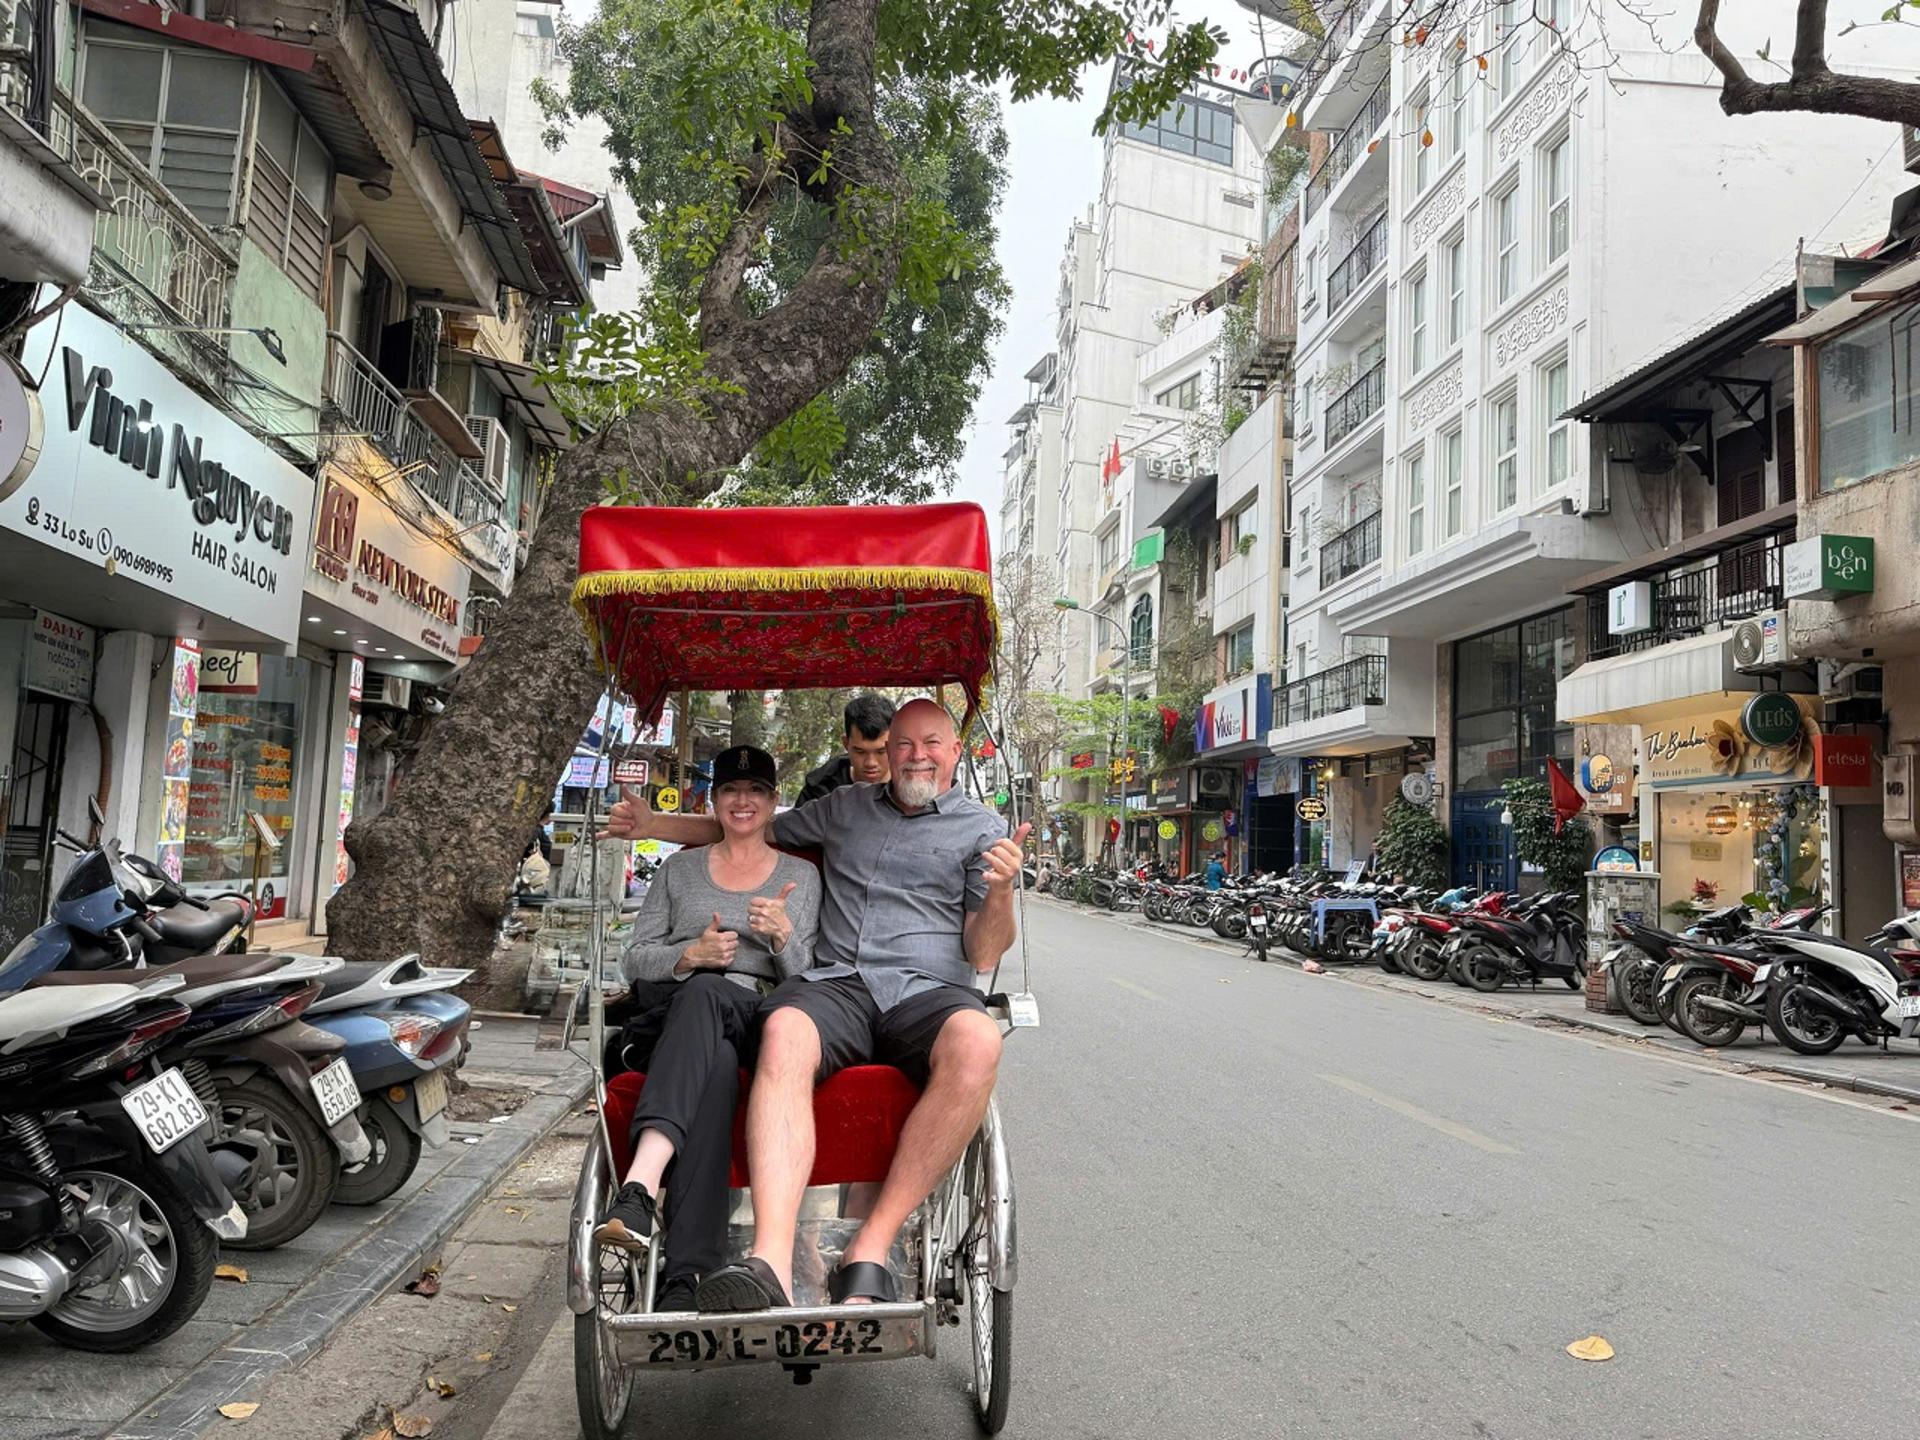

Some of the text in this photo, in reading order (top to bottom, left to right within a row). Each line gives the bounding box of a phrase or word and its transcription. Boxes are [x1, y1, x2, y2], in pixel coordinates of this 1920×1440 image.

[62, 346, 164, 480] Vinh
[167, 422, 294, 556] Nguyen
[43, 512, 59, 535] 33
[192, 531, 228, 571] HAIR
[231, 552, 277, 594] SALON
[355, 537, 394, 588] NEW
[391, 557, 430, 609] YORK
[424, 583, 461, 627] STEAK
[661, 794, 677, 804] 43
[133, 1076, 185, 1120] 29-K1
[317, 1064, 348, 1098] 29-K1
[323, 1083, 360, 1121] 659.09
[146, 1097, 203, 1147] 682.83
